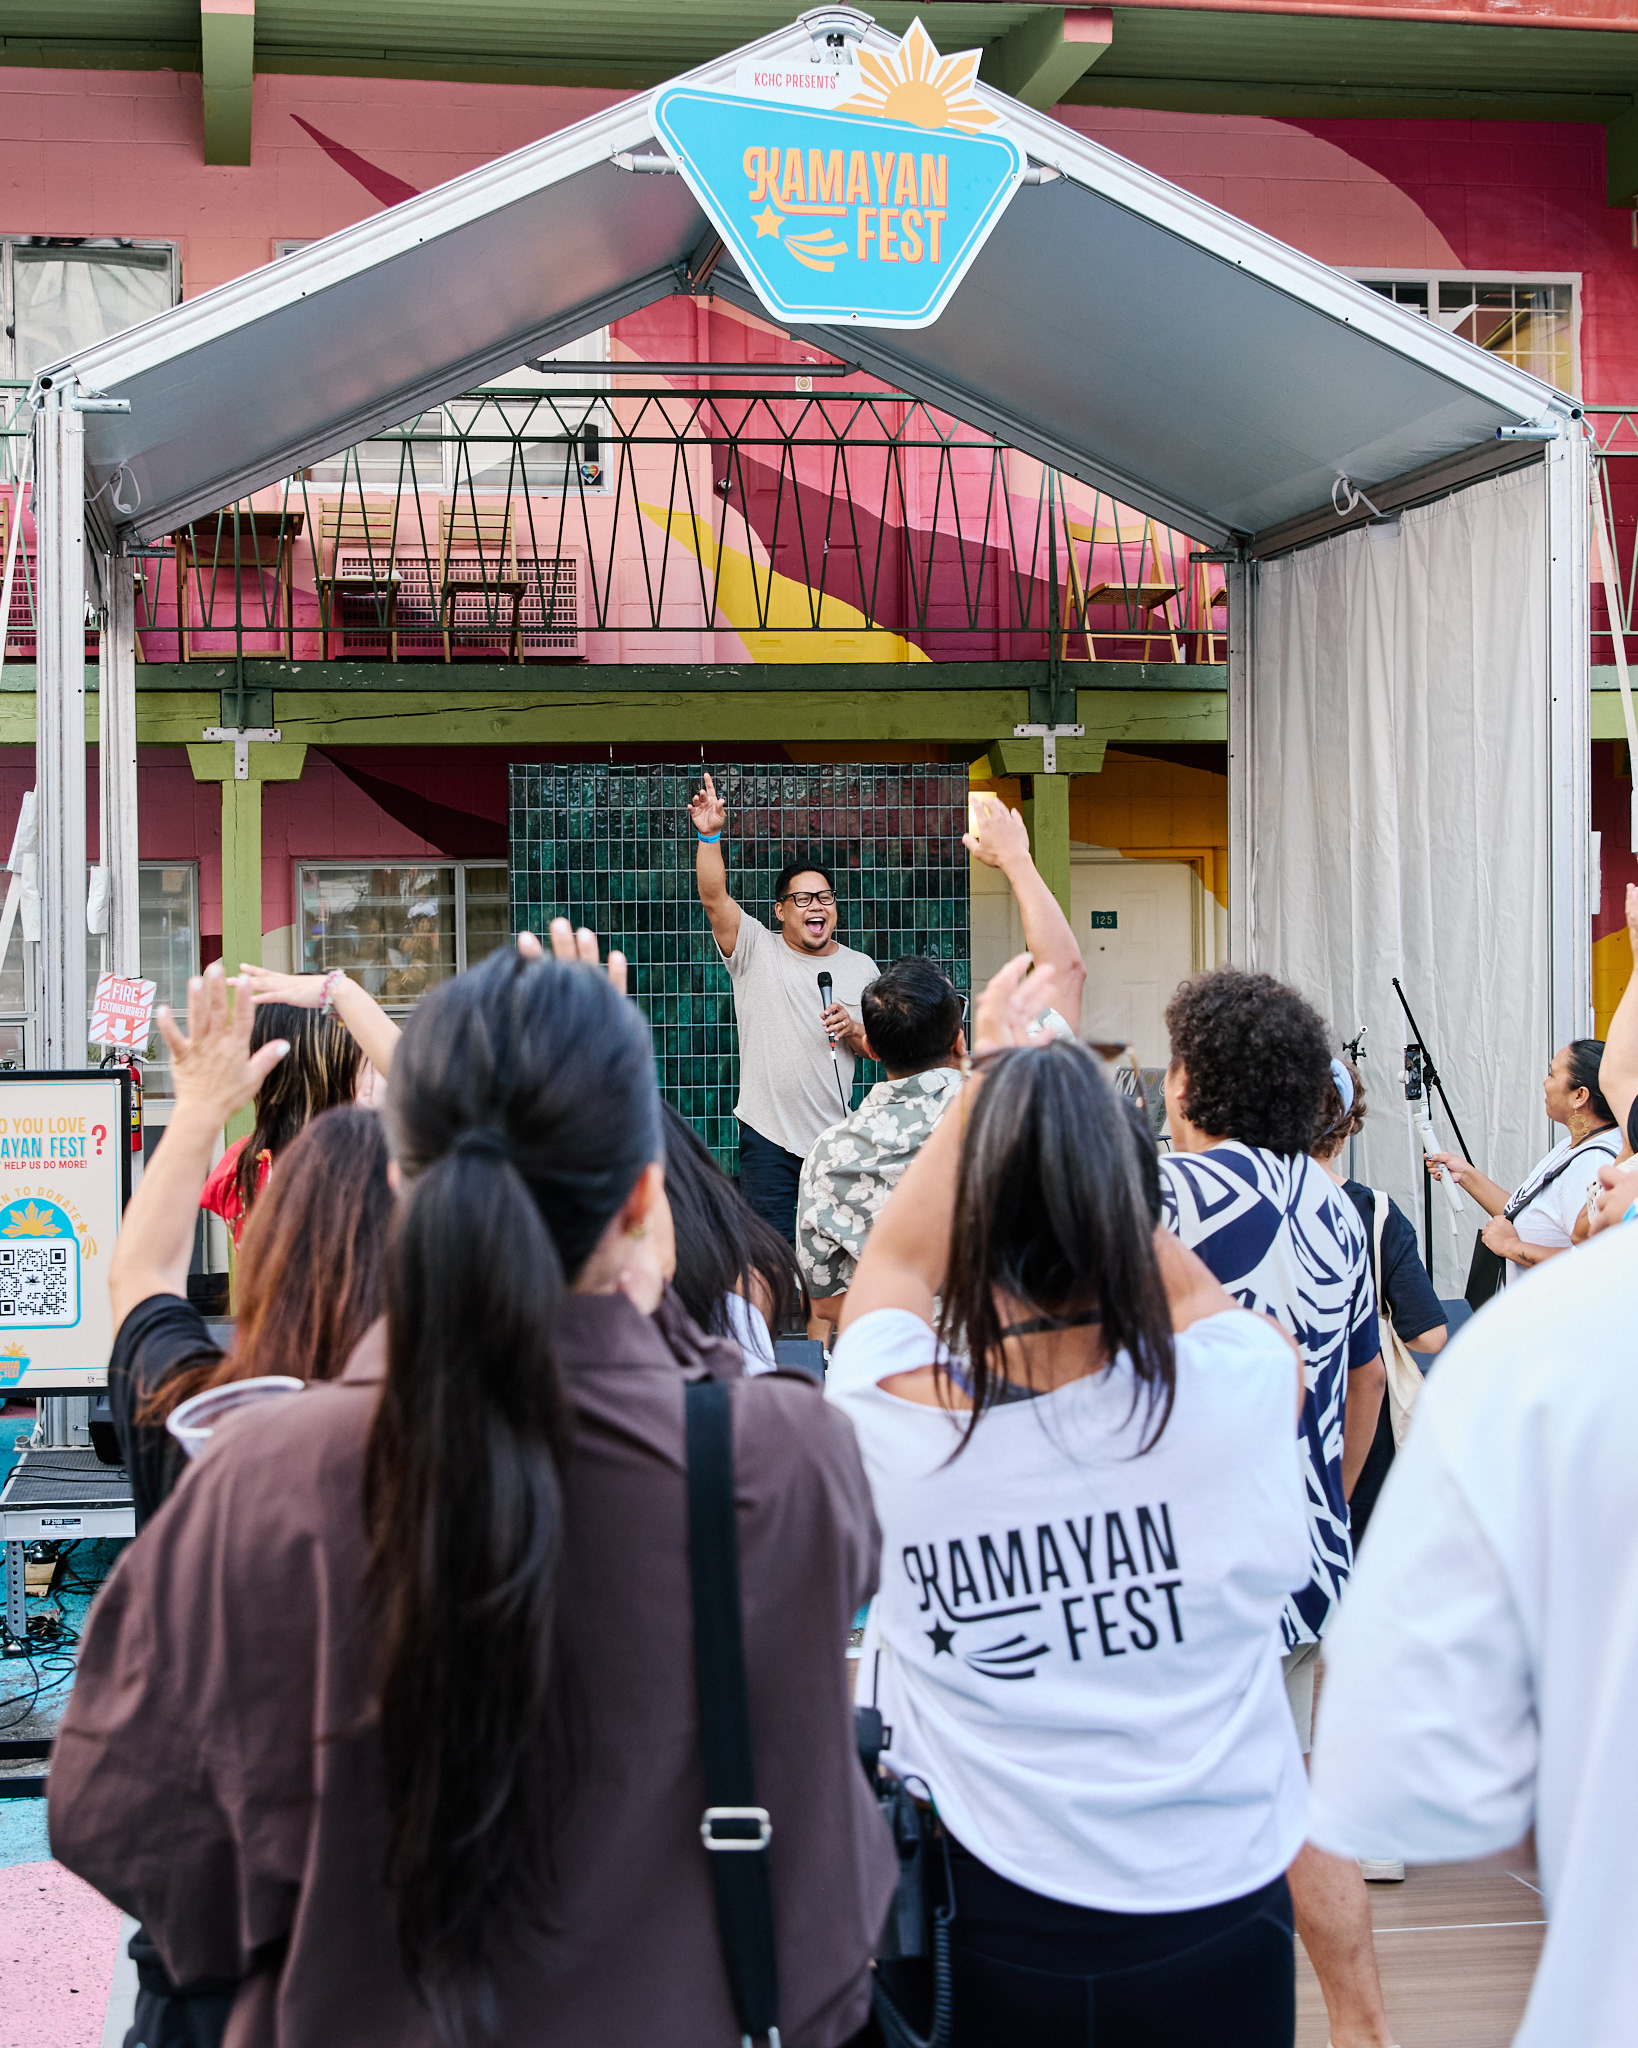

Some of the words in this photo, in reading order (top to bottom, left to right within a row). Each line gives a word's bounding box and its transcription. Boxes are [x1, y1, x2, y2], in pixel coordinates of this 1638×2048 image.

[754, 72, 782, 87] KCHC
[785, 74, 836, 89] PRESENTS
[743, 147, 948, 216] KAMAYAN
[857, 207, 947, 264] FEST
[1096, 915, 1113, 925] 125
[112, 982, 140, 1003] FIRE
[101, 1001, 146, 1018] EXTINGUISHER
[12, 1117, 43, 1134] YOU
[48, 1117, 86, 1134] LOVE
[0, 1137, 43, 1159] AYAN
[50, 1136, 88, 1159] FEST
[4, 1160, 27, 1170] HELP
[29, 1160, 41, 1169] US
[43, 1160, 56, 1169] DO
[58, 1160, 88, 1169] MORE!
[14, 1186, 31, 1197] TO
[37, 1186, 81, 1221] DONATE
[4, 1369, 19, 1378] FEST
[902, 1502, 1179, 1623] KAMAYAN
[1061, 1580, 1184, 1662] FEST
